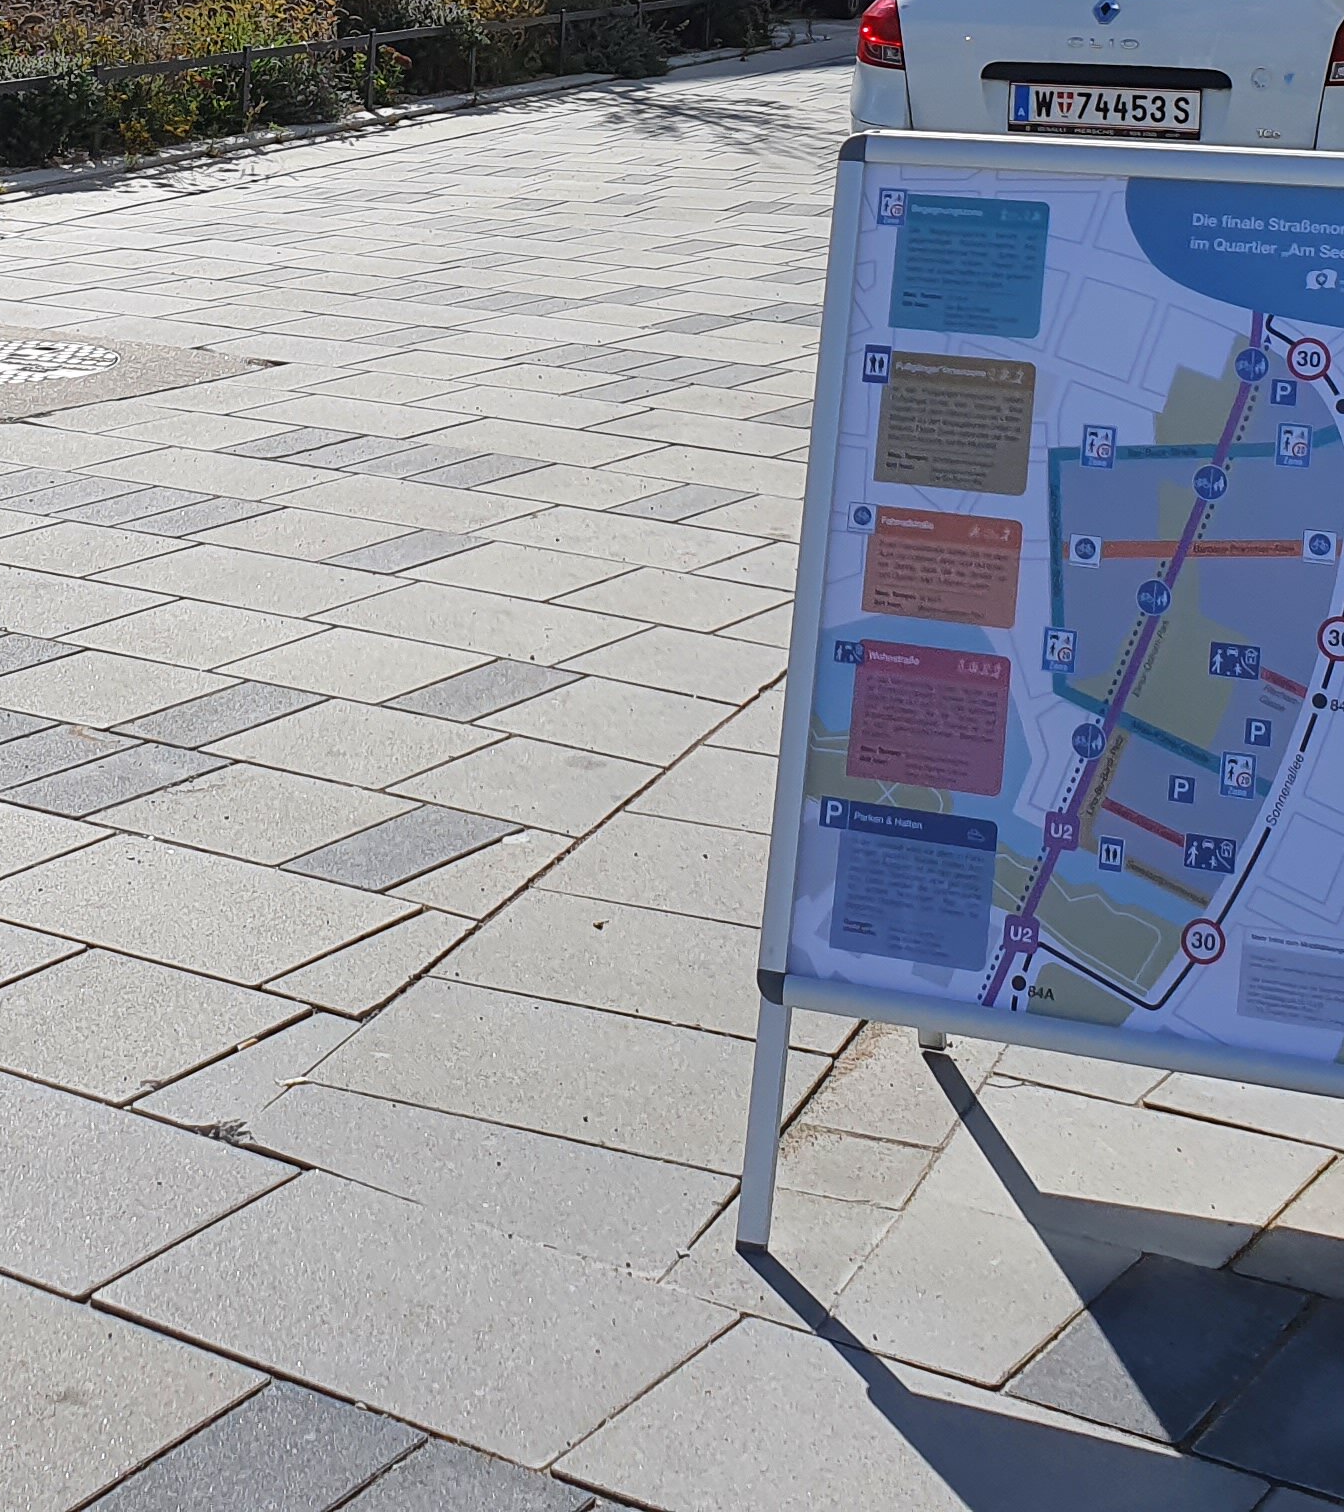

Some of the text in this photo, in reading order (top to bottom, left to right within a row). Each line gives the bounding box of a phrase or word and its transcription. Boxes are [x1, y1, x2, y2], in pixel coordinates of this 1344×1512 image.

[1067, 36, 1140, 50] CLIO
[1035, 90, 1190, 124] W 74453 S
[1192, 213, 1217, 227] Die
[1222, 214, 1264, 231] finale
[1190, 237, 1209, 250] im
[1213, 238, 1277, 254] Quartier
[1281, 245, 1315, 257] „Am
[1296, 350, 1321, 368] 30
[1275, 383, 1292, 401] P
[1250, 721, 1267, 743] P
[1173, 778, 1189, 800] P
[1265, 753, 1305, 827] Sonnenallee
[825, 800, 843, 824] P
[853, 810, 885, 825] Parken
[894, 816, 924, 831] Halten
[1050, 822, 1074, 840] U2
[1009, 925, 1033, 943] U2
[1191, 931, 1216, 951] 30
[1027, 985, 1055, 1001] 84A
